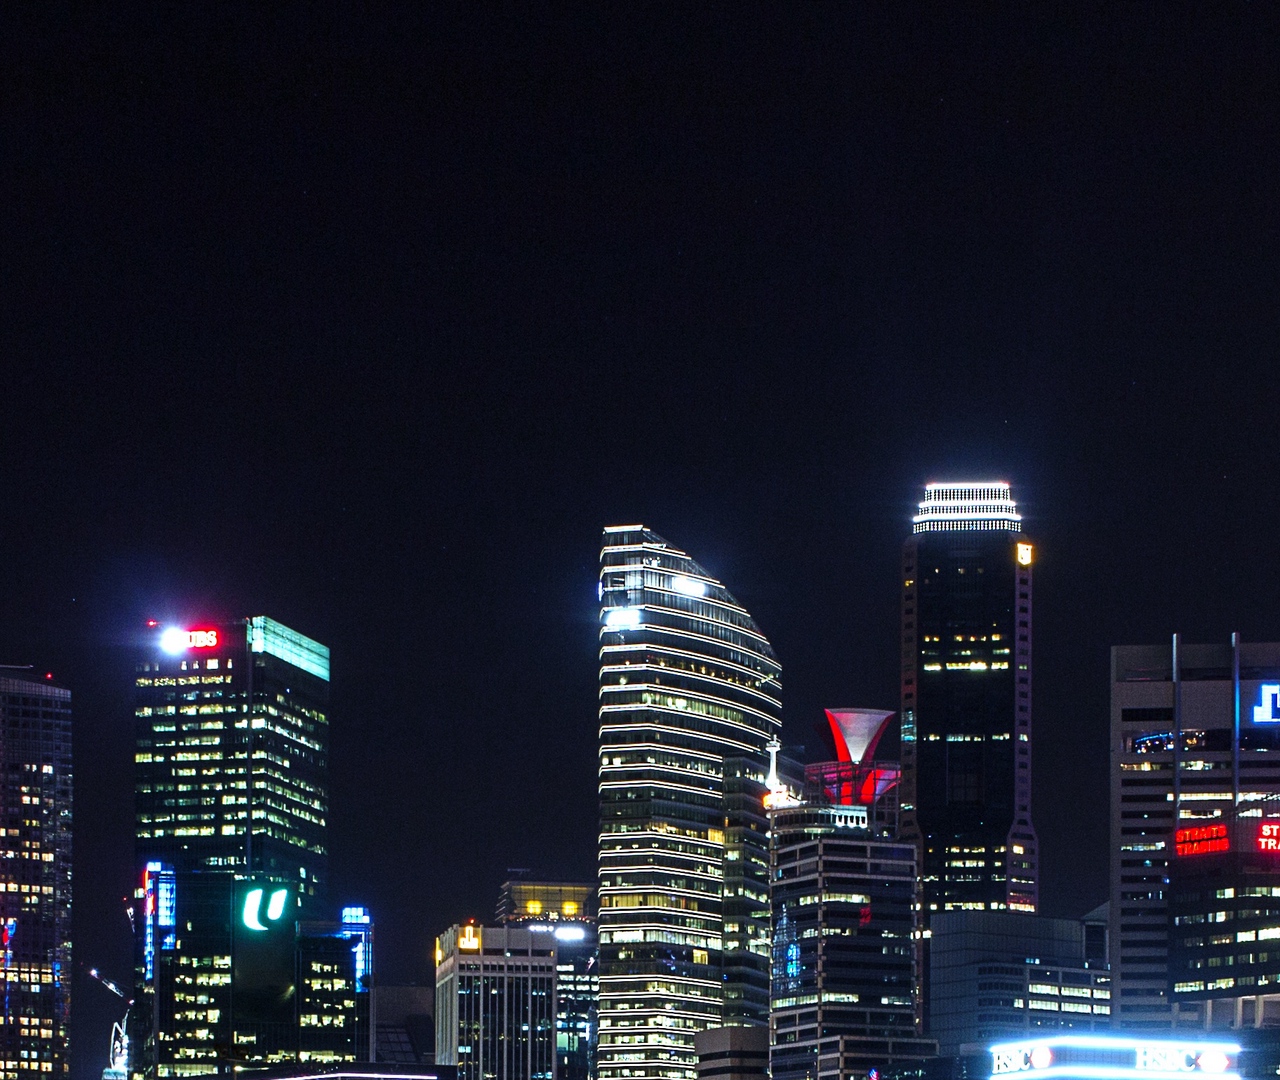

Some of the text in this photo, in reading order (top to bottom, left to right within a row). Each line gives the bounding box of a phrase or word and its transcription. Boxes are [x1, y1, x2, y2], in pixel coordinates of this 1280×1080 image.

[1175, 824, 1227, 842] STRAITS
[1177, 838, 1230, 856] TRADING
[992, 1050, 1031, 1074] HSBC
[1134, 1047, 1196, 1072] HSBC
